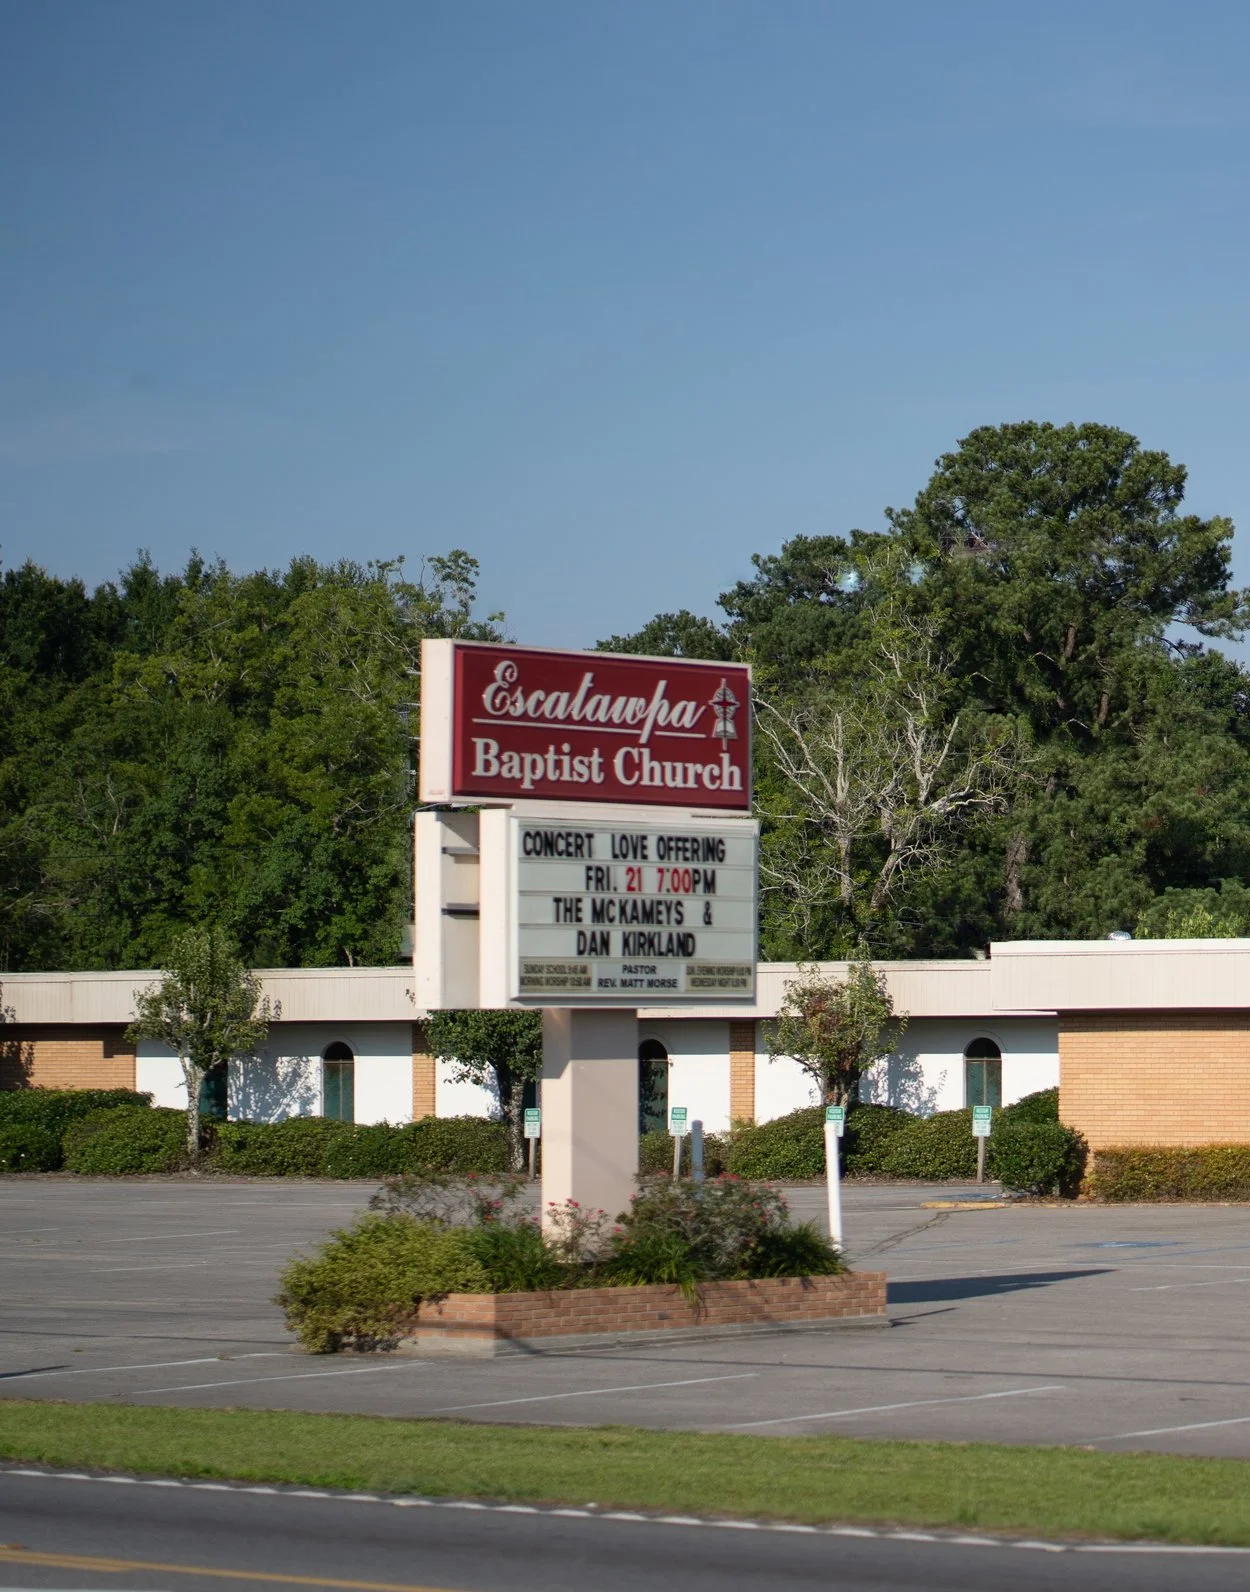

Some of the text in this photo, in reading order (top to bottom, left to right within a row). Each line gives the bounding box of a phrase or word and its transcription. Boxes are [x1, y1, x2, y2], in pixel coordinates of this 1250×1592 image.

[482, 660, 706, 743] Escatawpa
[471, 737, 743, 791] Baptist Church
[522, 830, 726, 863] CONCERT LOVE OFFERING
[585, 865, 618, 892] FRI.
[625, 867, 642, 892] 21
[553, 897, 583, 923] THE
[703, 901, 713, 926] &
[577, 930, 696, 957] DAN KIRKLAND
[597, 978, 678, 988] REV. MATT MORSE
[622, 964, 657, 975] PASTOR
